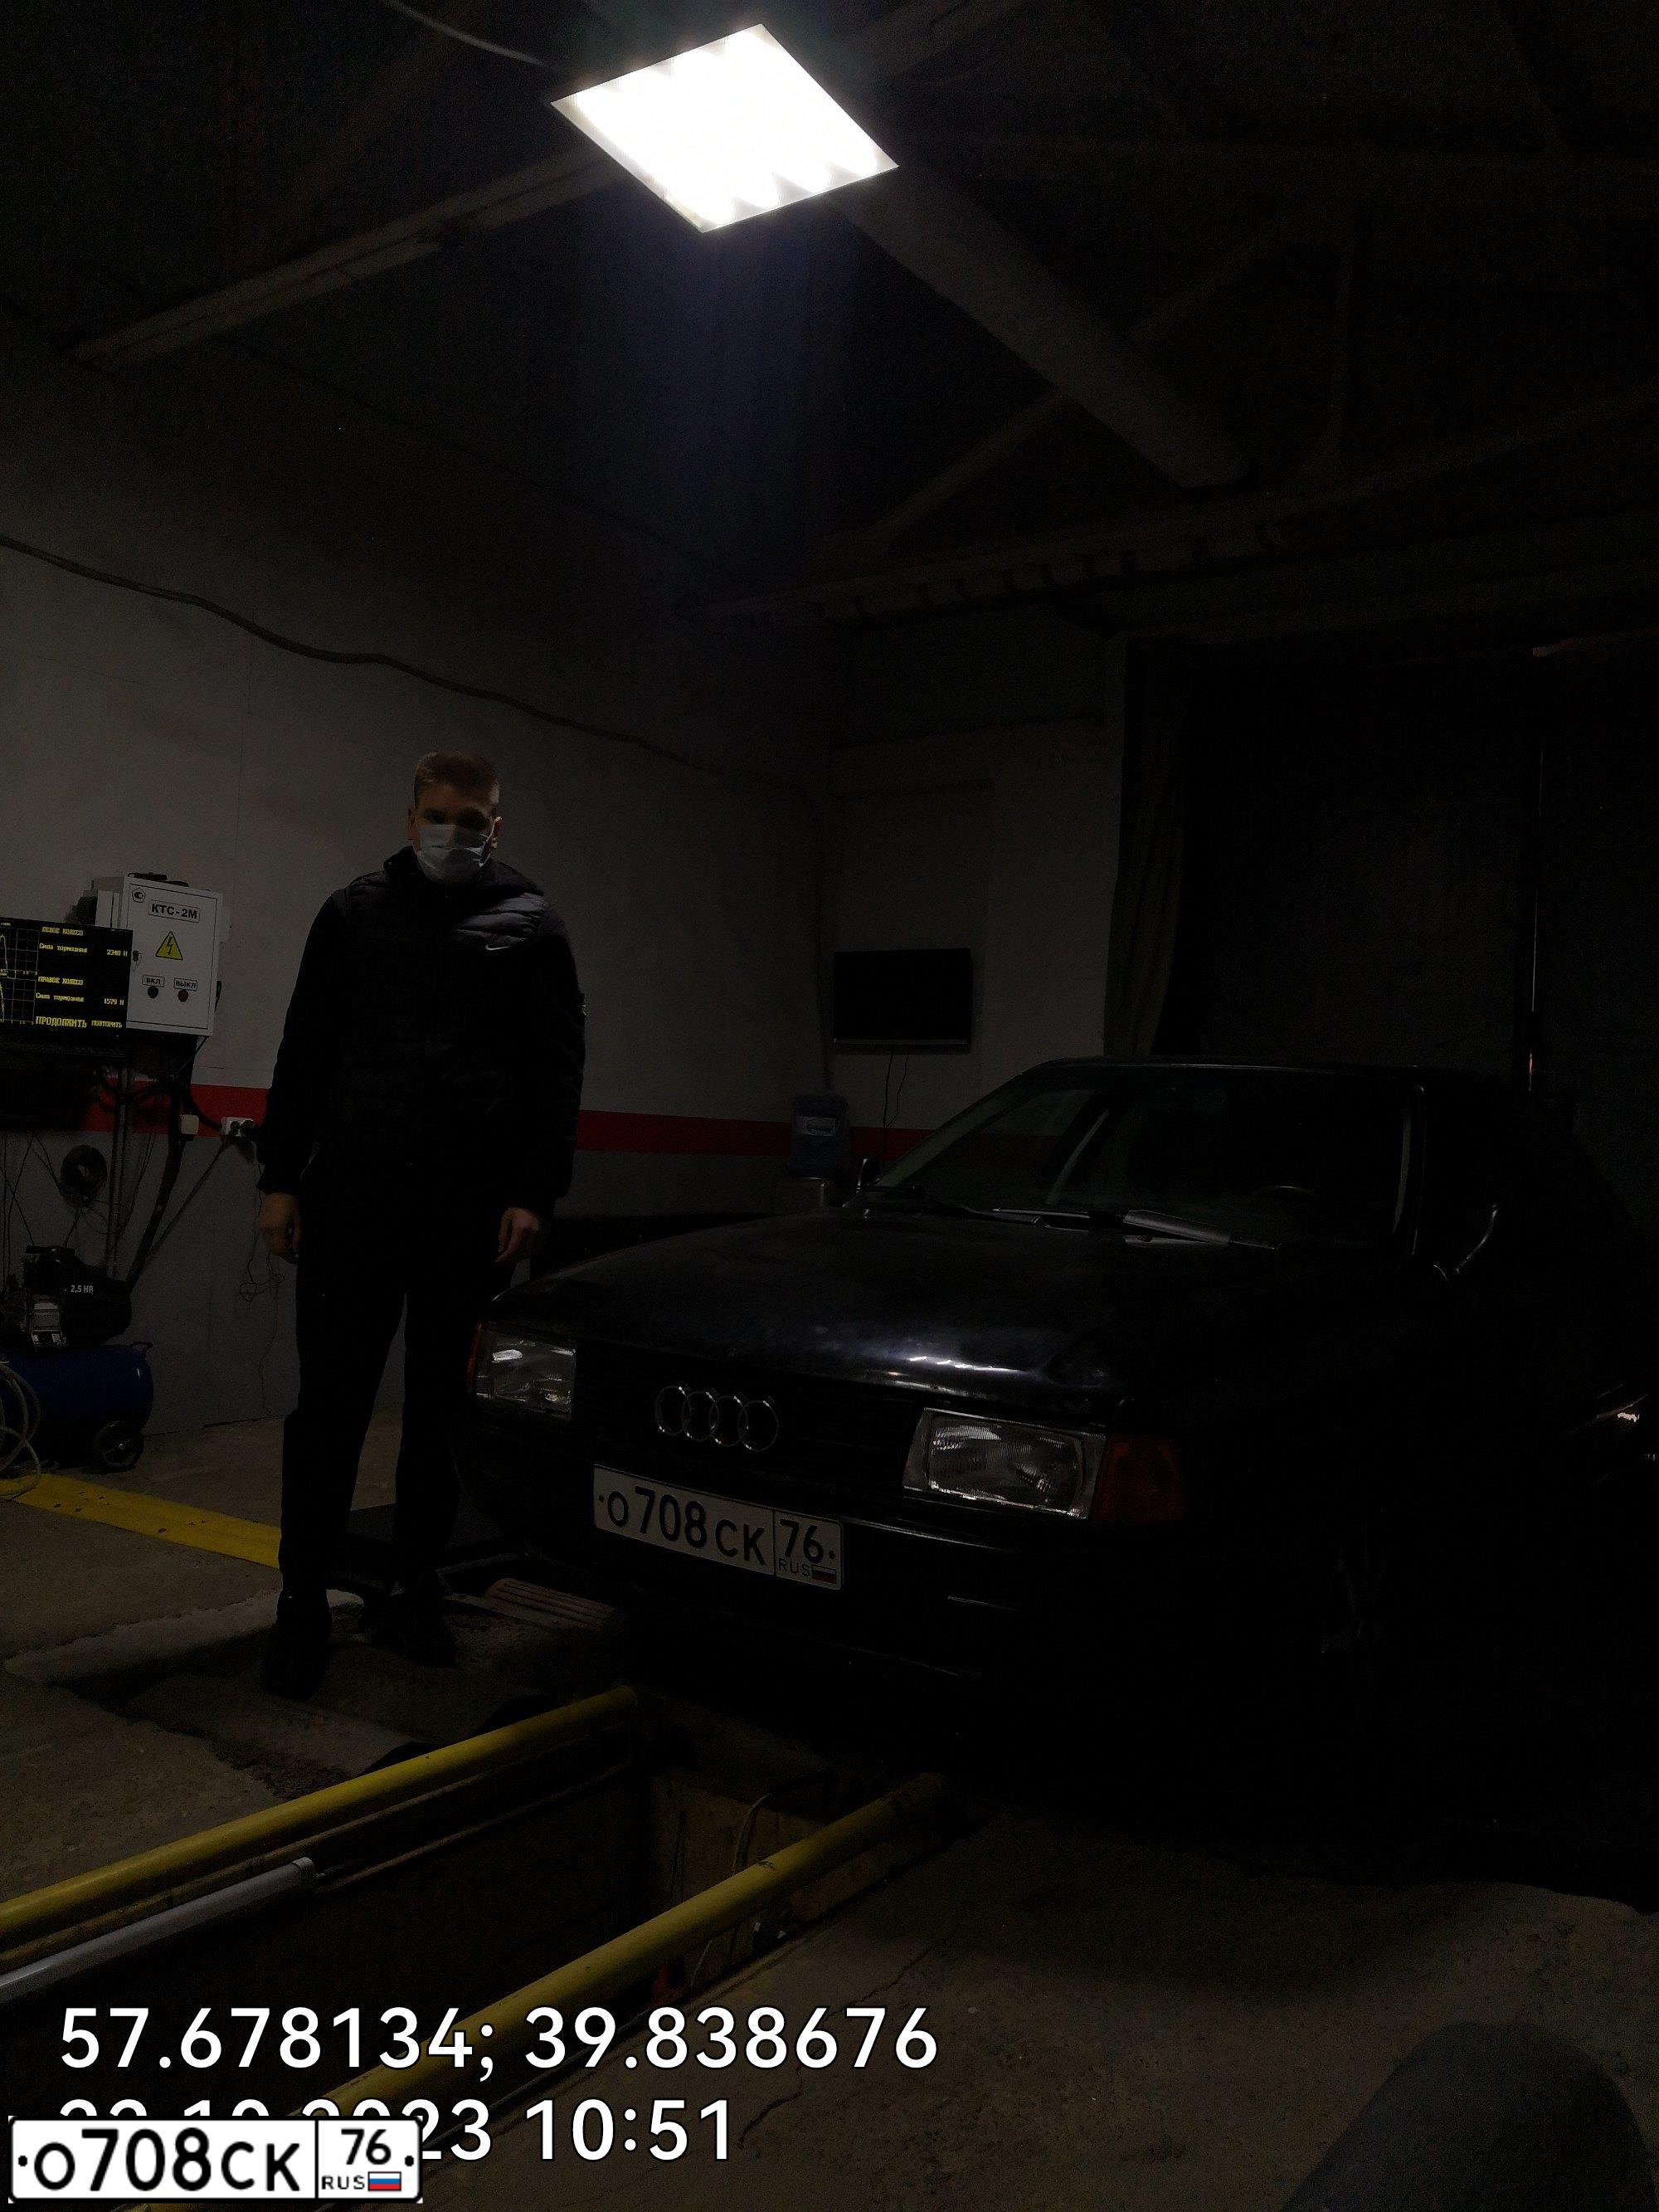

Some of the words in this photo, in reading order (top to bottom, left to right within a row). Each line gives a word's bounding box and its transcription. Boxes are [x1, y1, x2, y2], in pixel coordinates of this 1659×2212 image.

[151, 903, 197, 919] КТС-2М
[36, 1016, 88, 1028] ПРОДОЛЖИТЬ
[607, 1486, 766, 1566] О708СК
[779, 1519, 824, 1563] 76
[777, 1557, 810, 1578] RUS
